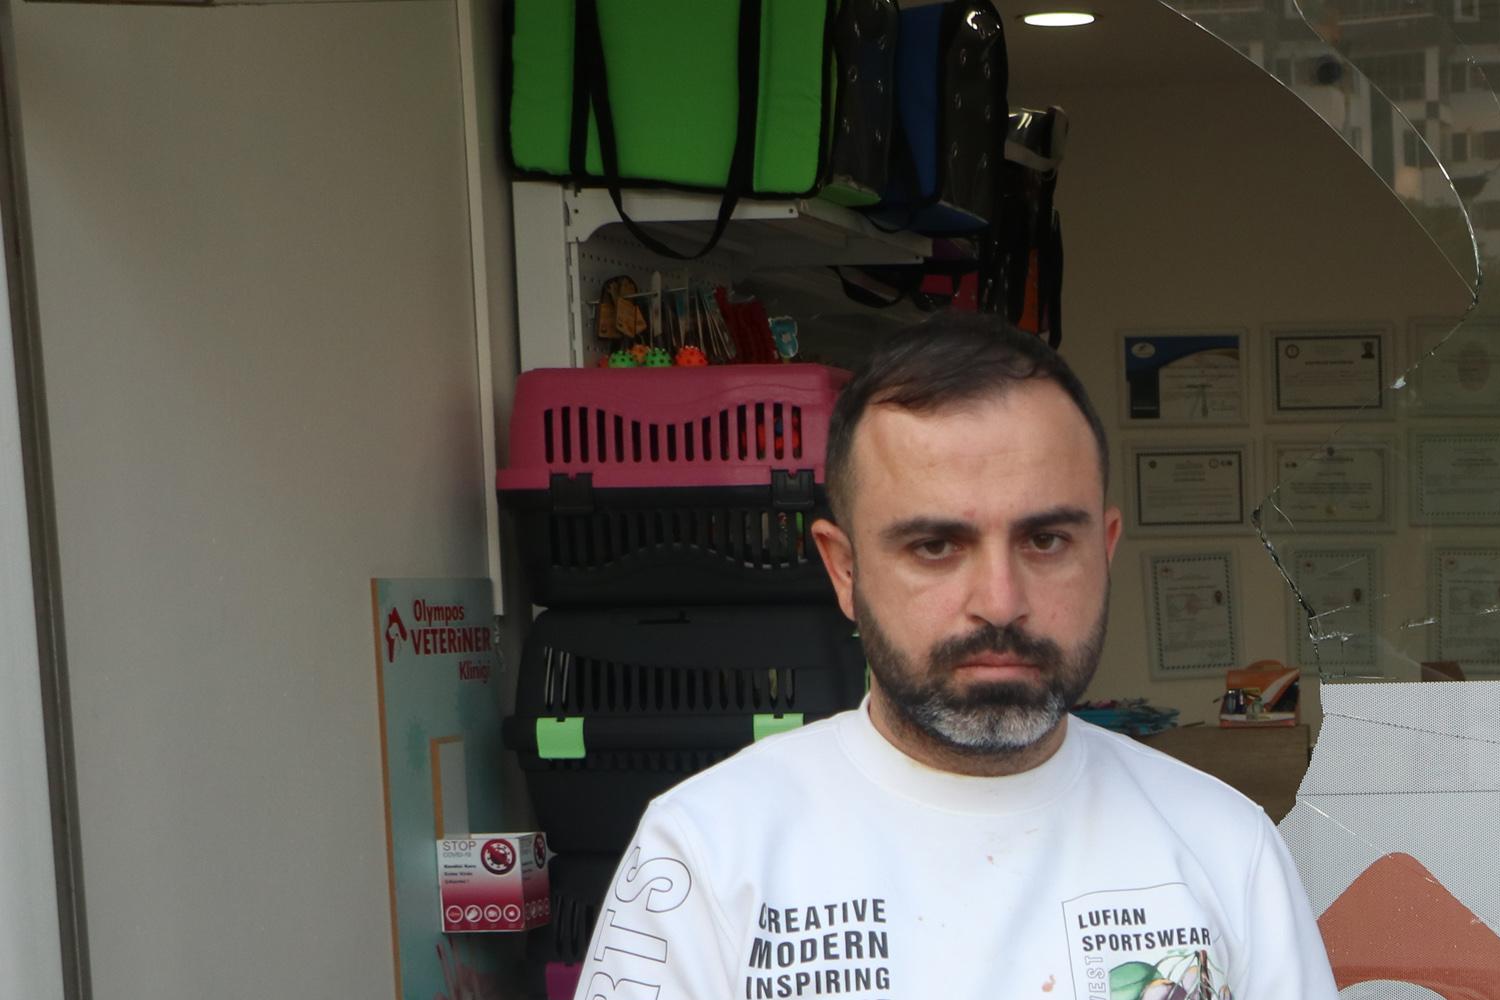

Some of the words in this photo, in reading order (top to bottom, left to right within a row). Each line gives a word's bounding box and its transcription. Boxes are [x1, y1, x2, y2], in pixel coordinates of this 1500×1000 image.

[413, 599, 465, 627] Olympos
[442, 840, 477, 851] STOP
[758, 898, 887, 934] CREATIVE
[1078, 908, 1146, 929] LUFIAN
[748, 930, 889, 970] MODERN
[1082, 927, 1211, 952] SPORTSWEAR
[745, 967, 890, 1000] INSPIRING
